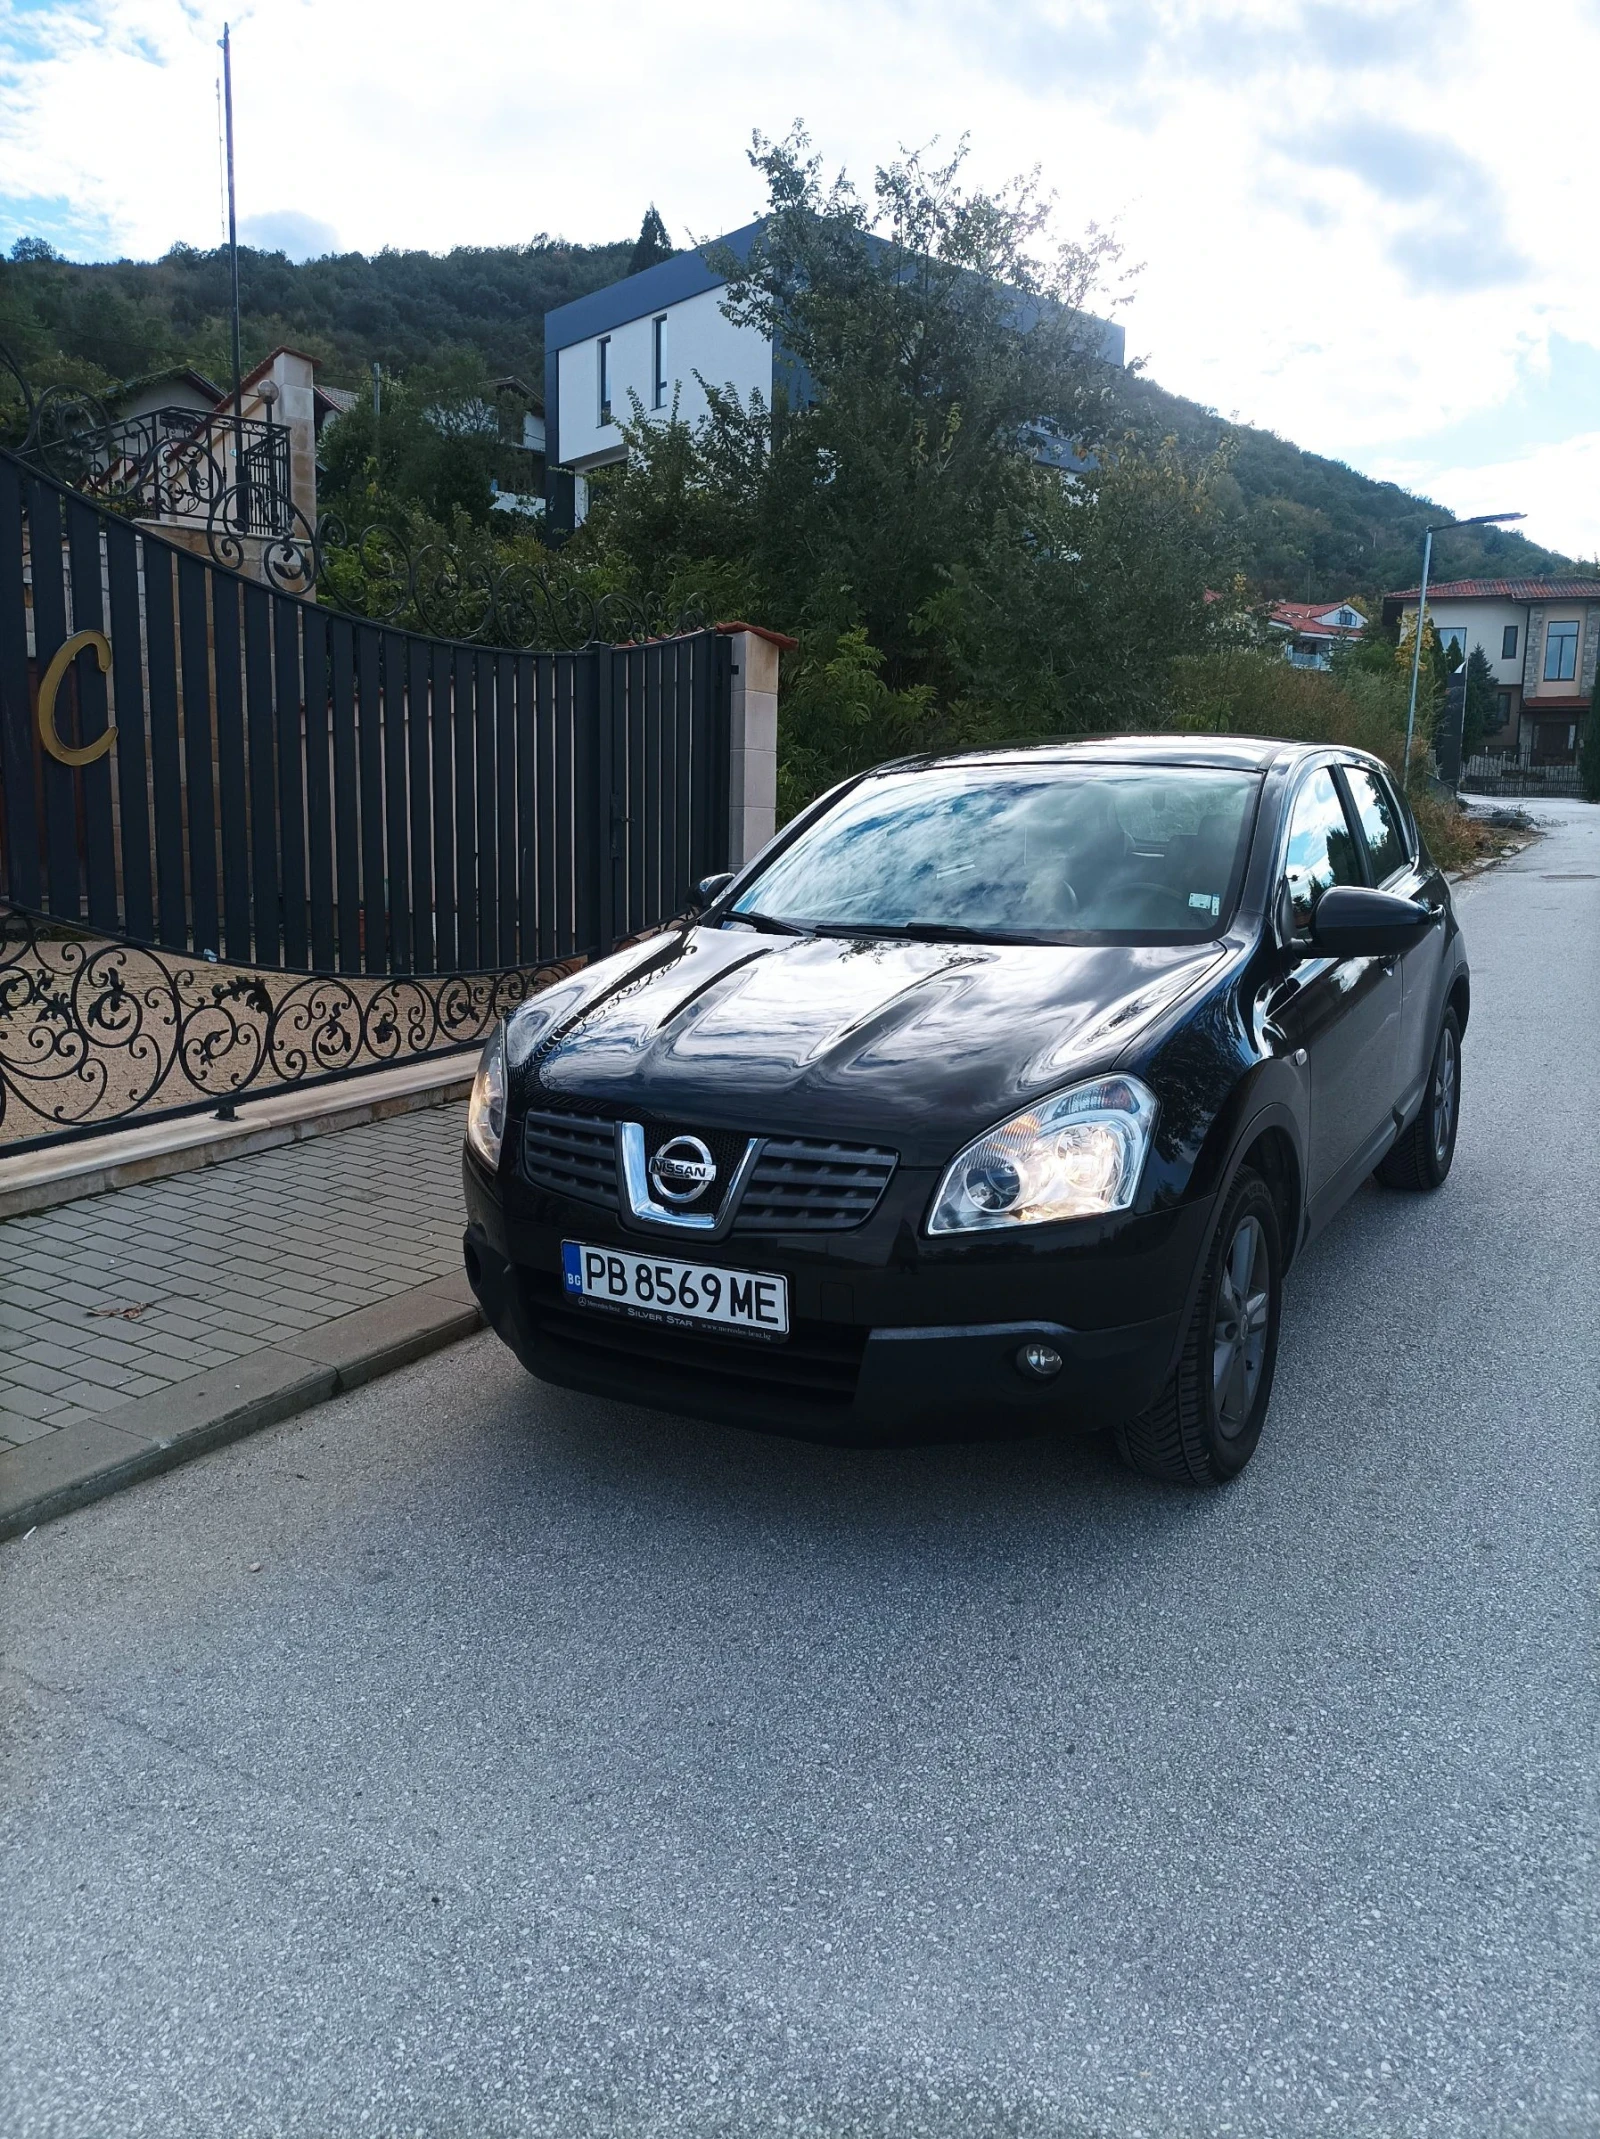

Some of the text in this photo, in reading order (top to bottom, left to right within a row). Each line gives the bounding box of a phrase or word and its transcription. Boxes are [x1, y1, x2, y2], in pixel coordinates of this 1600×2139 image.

[652, 1159, 707, 1178] NISSAN
[567, 1273, 581, 1286] BG
[585, 1252, 779, 1324] PB 8569 ME
[627, 1308, 663, 1321] SILVER
[666, 1315, 693, 1327] STAR
